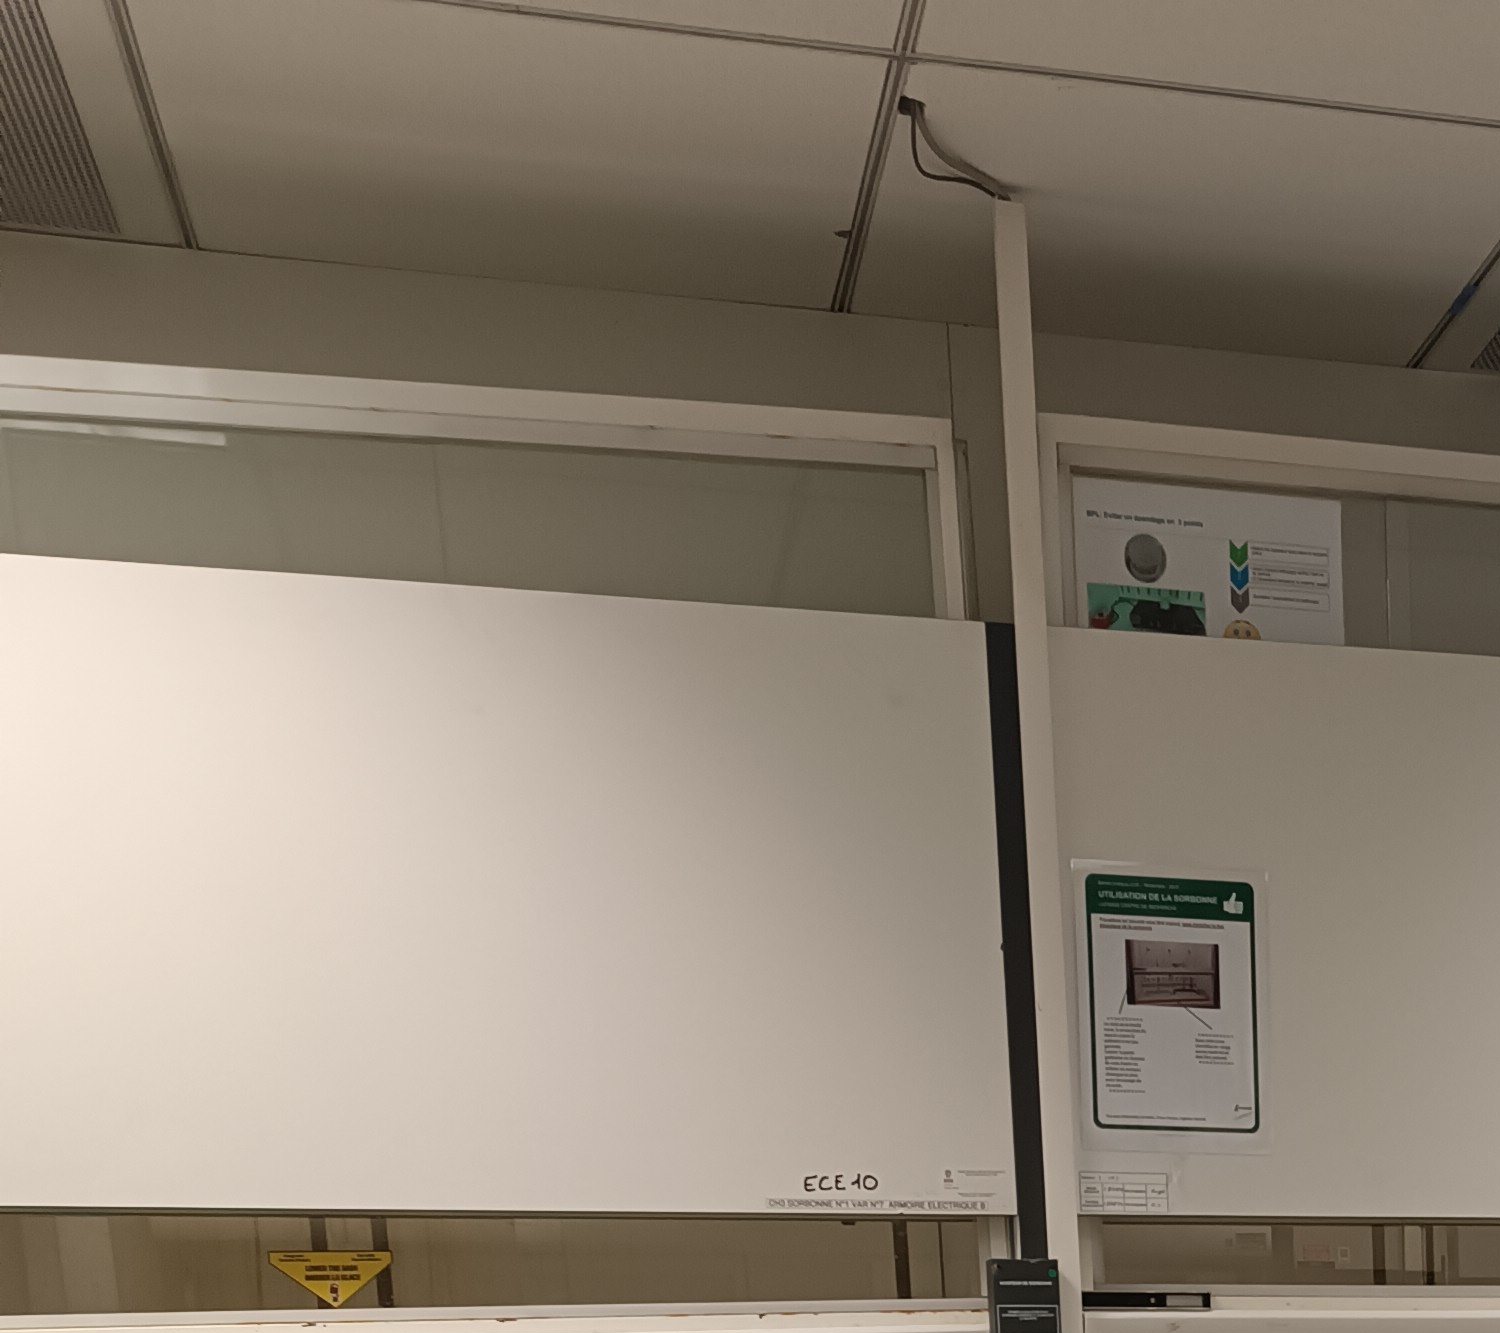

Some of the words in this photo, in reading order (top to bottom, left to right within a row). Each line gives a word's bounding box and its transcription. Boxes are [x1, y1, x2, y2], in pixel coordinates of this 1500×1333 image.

[1098, 890, 1147, 901] UTILISATION
[1148, 893, 1160, 902] DE
[1161, 894, 1173, 902] LA
[1173, 895, 1218, 905] SORBONNE
[803, 1174, 846, 1192] ECE
[851, 1173, 879, 1191] 10
[787, 1199, 833, 1209] SORBONNE
